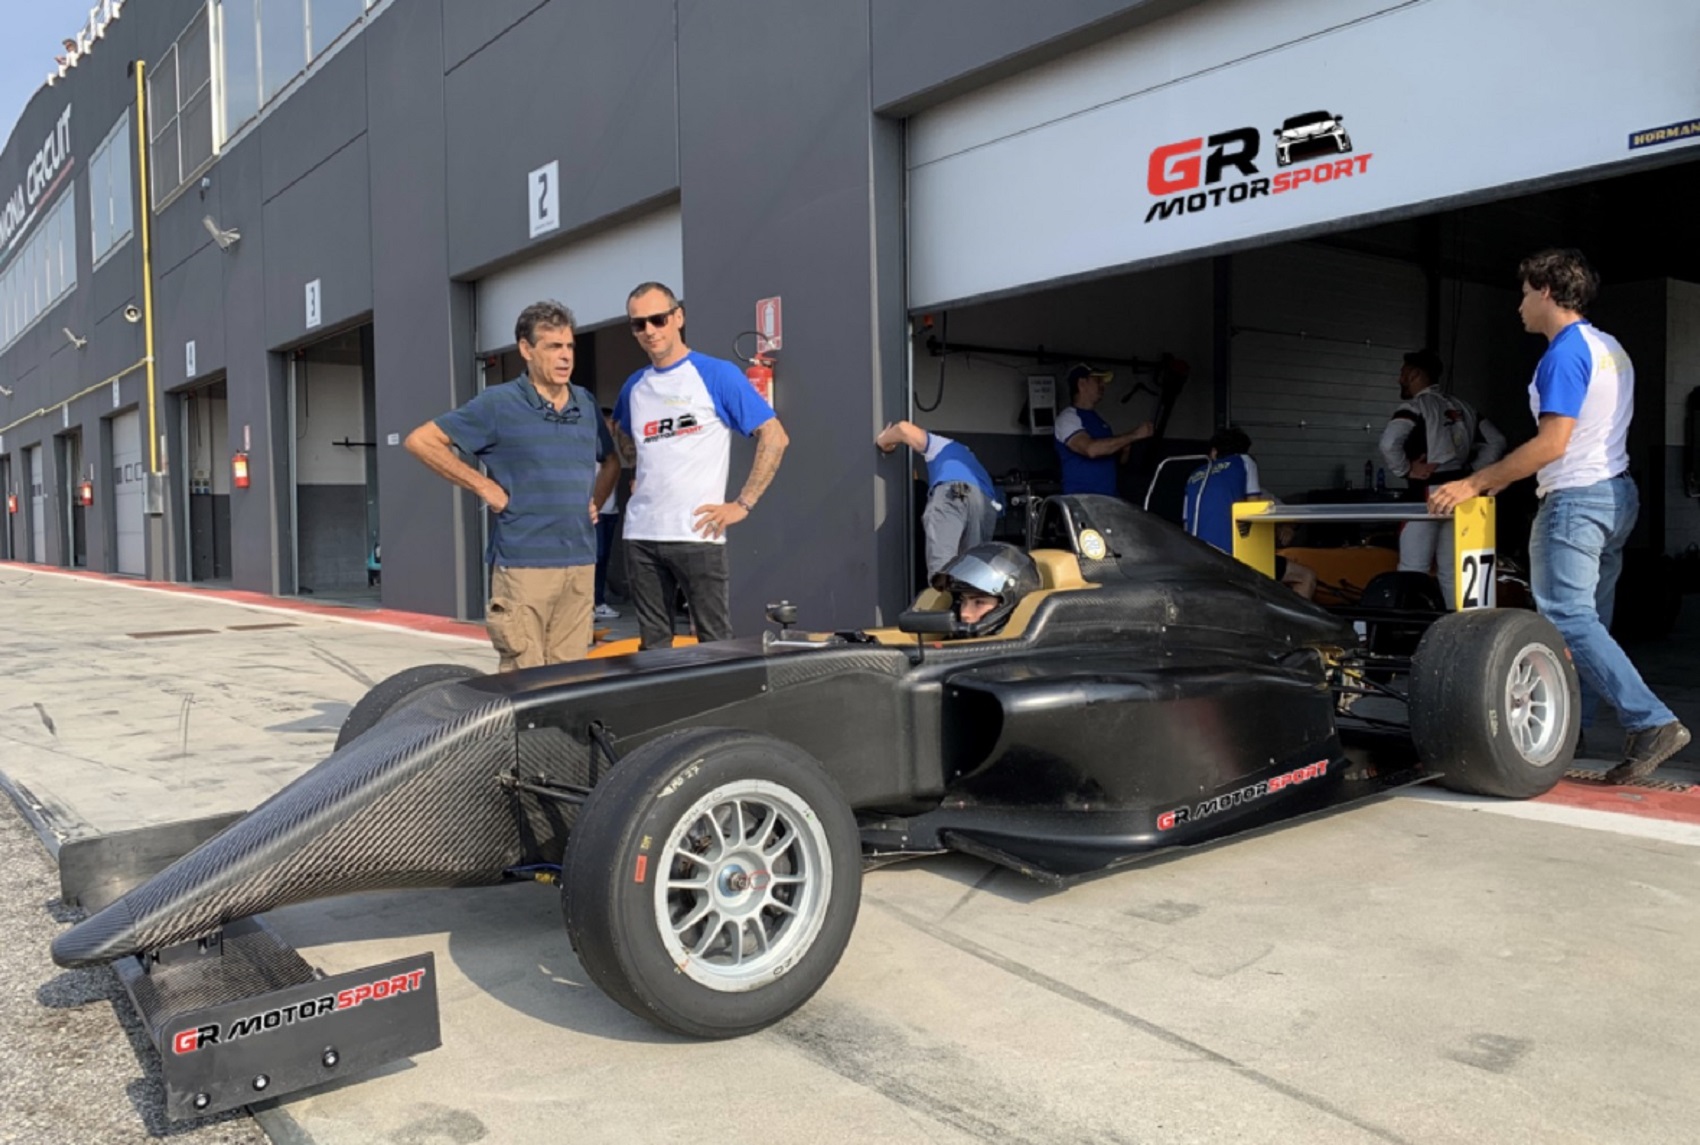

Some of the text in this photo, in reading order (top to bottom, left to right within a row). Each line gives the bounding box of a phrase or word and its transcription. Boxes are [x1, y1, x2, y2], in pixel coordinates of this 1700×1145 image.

[27, 102, 72, 206] CIRCUIT
[1144, 152, 1374, 224] MOTORSPORT
[1146, 126, 1260, 197] GR
[538, 171, 548, 220] 2
[643, 417, 674, 437] GR
[1462, 553, 1495, 609] 27
[1156, 758, 1329, 831] GR MOTORSPORT
[173, 967, 426, 1056] GR MOTORSPORT
